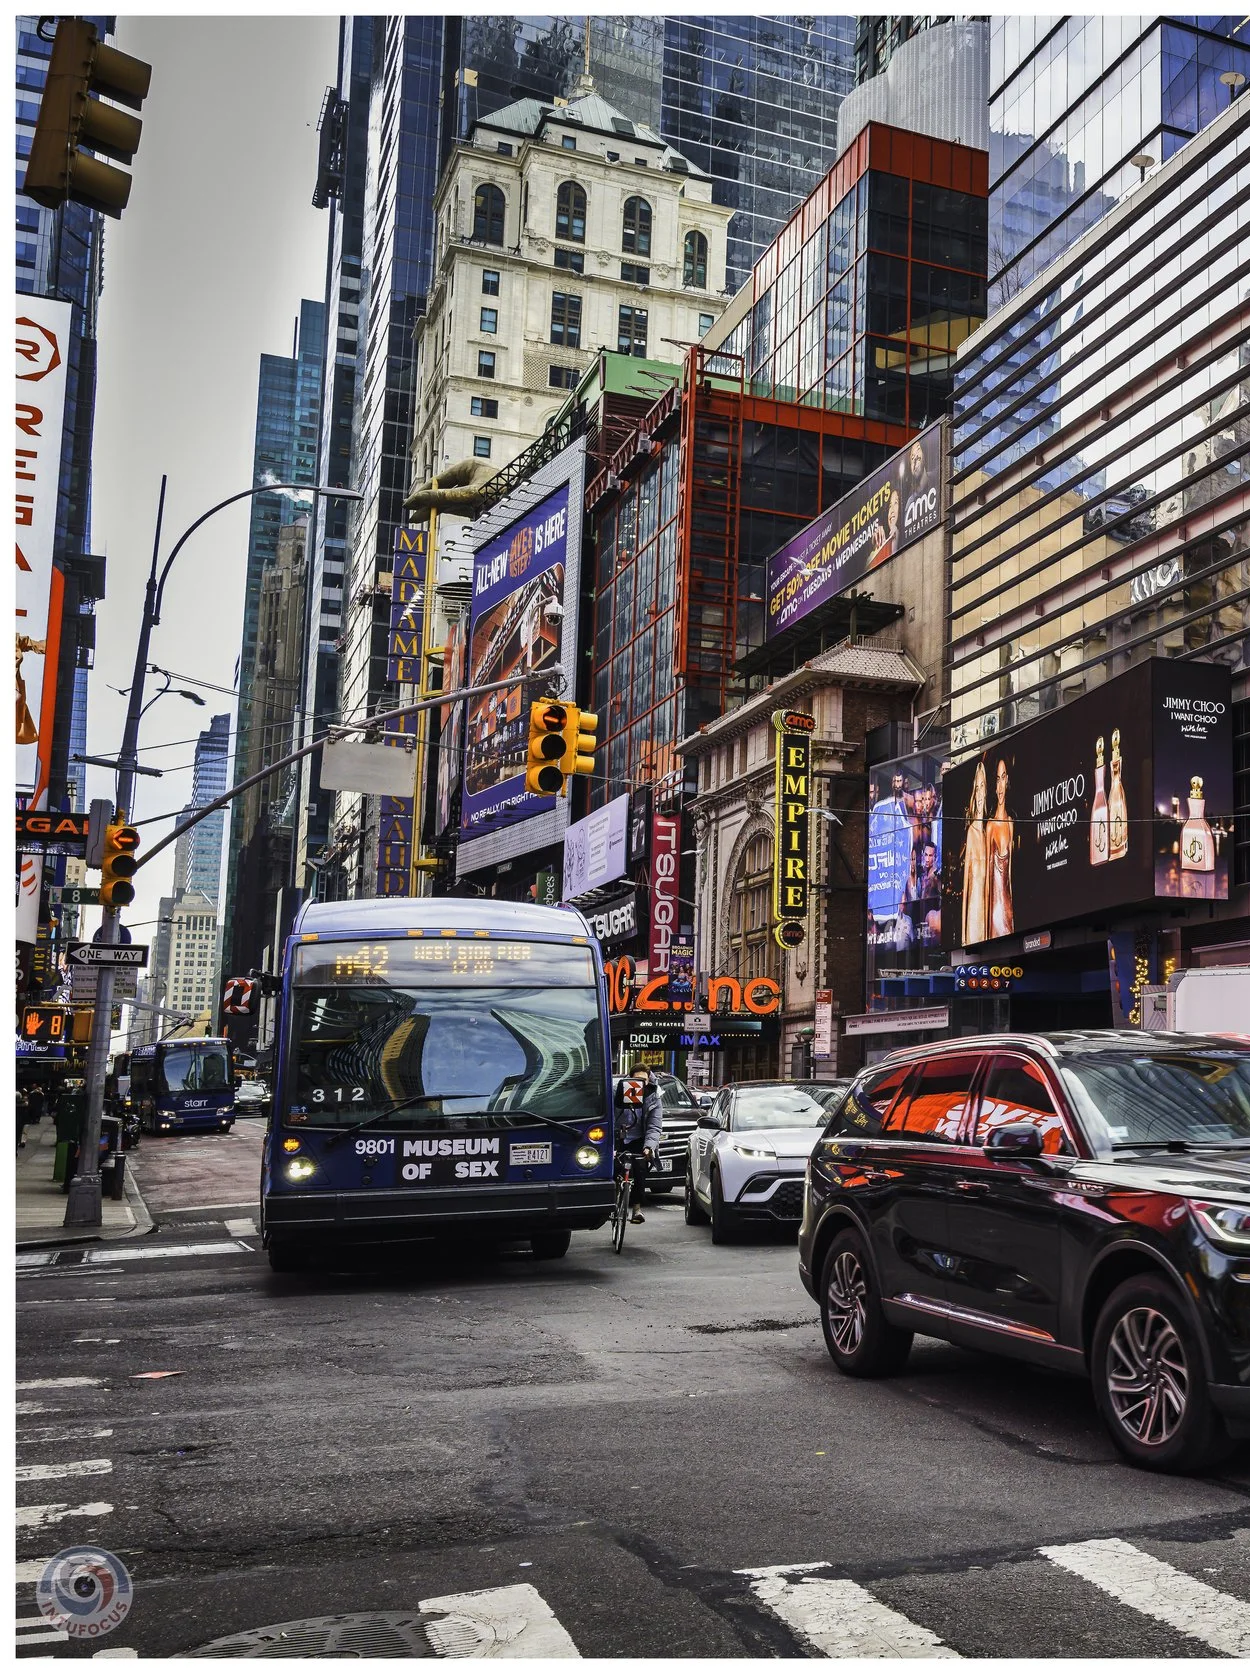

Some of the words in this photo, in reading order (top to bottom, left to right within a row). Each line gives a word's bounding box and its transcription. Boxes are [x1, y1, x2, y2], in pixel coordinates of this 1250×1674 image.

[904, 487, 937, 527] amc
[904, 510, 937, 539] THEATRES
[475, 549, 509, 596] ALL-NEW
[534, 523, 543, 555] IS
[544, 507, 566, 549] HERE
[770, 590, 785, 616] GET
[786, 570, 803, 601] 50%
[821, 521, 850, 566] MOVIE
[850, 481, 891, 535] TICKETS
[780, 597, 798, 624] amc
[803, 564, 832, 602] TUESDAYS
[835, 518, 879, 570] WEDNESDAYS
[393, 530, 425, 682] MADAME
[1162, 697, 1192, 712] JIMMY
[1193, 700, 1226, 714] CHOO
[786, 714, 814, 729] amc
[1174, 712, 1195, 722] WANT
[1194, 714, 1218, 724] CHOO
[511, 791, 529, 805] RIGHT
[1031, 784, 1055, 818] JIMMY
[1055, 773, 1085, 806] CHOO
[784, 747, 808, 908] EMPIRE
[1037, 822, 1041, 837] I
[1040, 815, 1057, 837] WANT
[1056, 807, 1078, 833] CHOO
[72, 890, 80, 902] 8
[79, 950, 103, 959] ONE
[113, 951, 138, 961] WAY
[336, 945, 389, 975] M42
[414, 945, 449, 960] WEST
[457, 945, 492, 960] SIDE
[497, 945, 531, 960] PIER
[452, 961, 468, 975] 12
[51, 1015, 61, 1035] 8
[629, 1034, 667, 1044] DOLBY
[680, 1035, 721, 1045] IMAX
[184, 1099, 208, 1108] starr
[355, 1139, 395, 1155] 9801
[403, 1138, 499, 1157] MUSEUM
[402, 1163, 432, 1180] OF
[455, 1161, 499, 1179] SEX
